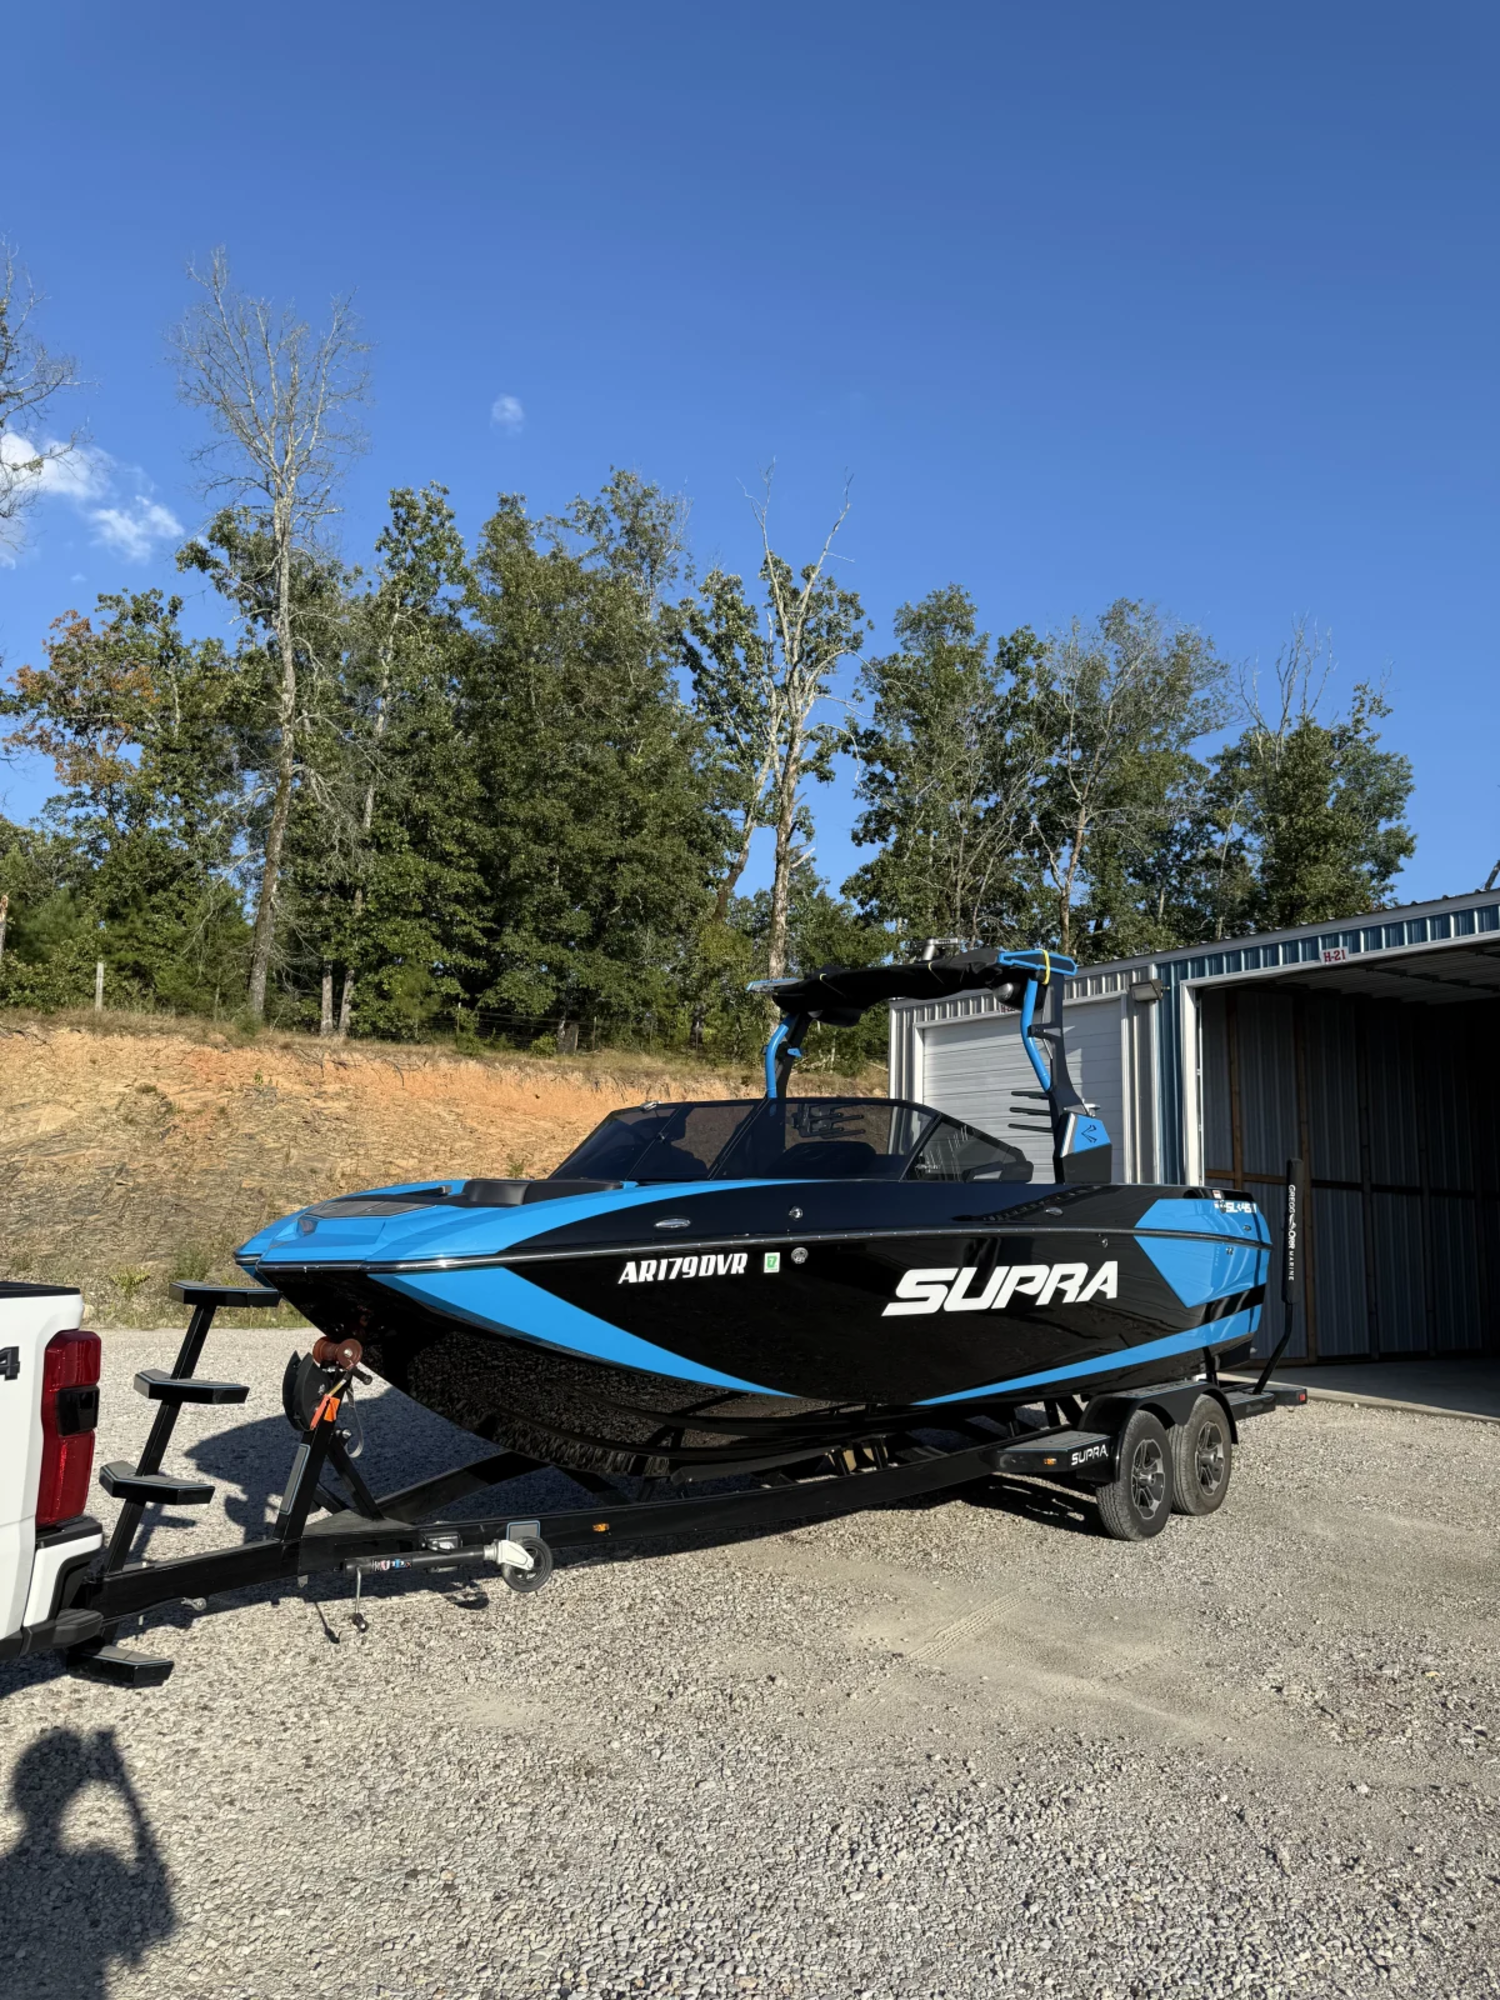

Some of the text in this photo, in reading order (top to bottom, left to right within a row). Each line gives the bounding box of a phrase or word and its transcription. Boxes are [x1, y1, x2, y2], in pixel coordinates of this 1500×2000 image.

[1323, 949, 1346, 963] H-21
[1288, 1184, 1296, 1214] GREGG
[881, 1260, 1118, 1317] SUPRA
[1070, 1443, 1109, 1466] SUPRA
